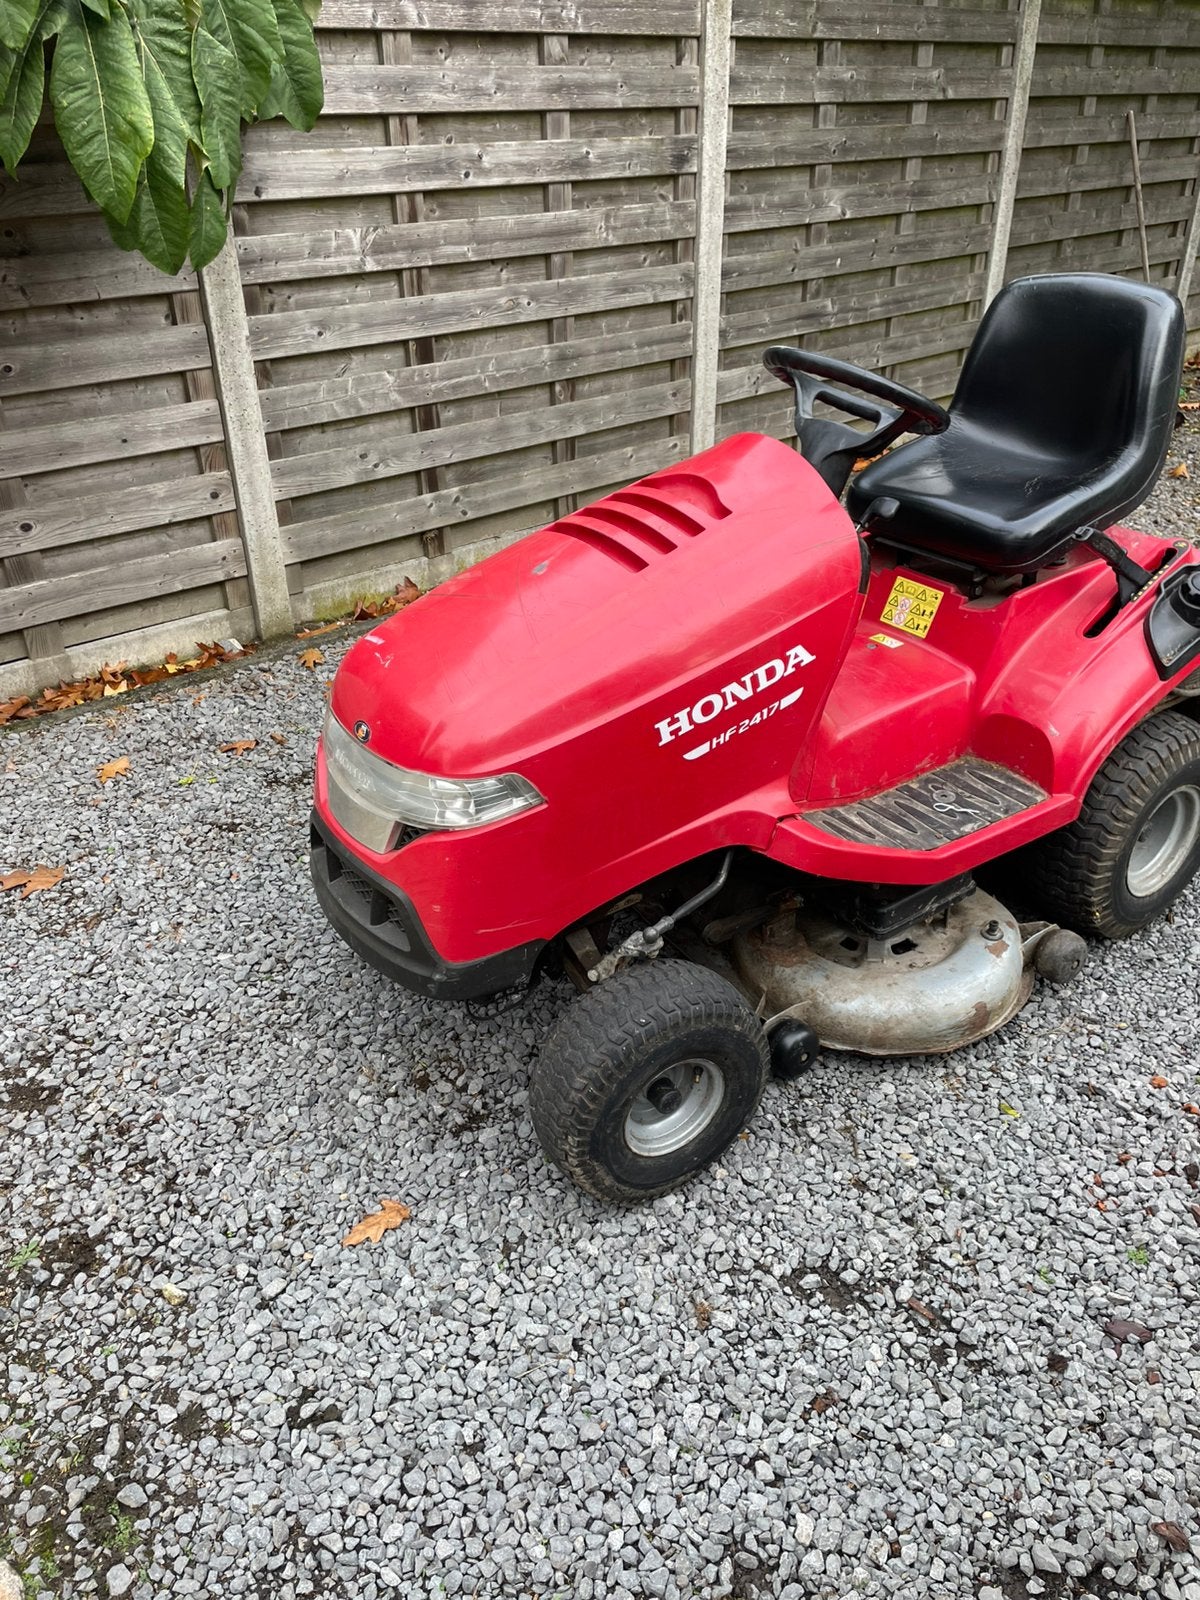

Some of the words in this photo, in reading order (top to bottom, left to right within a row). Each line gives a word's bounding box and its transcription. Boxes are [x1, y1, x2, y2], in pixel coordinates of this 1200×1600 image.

[654, 644, 816, 747] HONDA
[711, 725, 737, 749] HF
[738, 701, 780, 734] 2417
